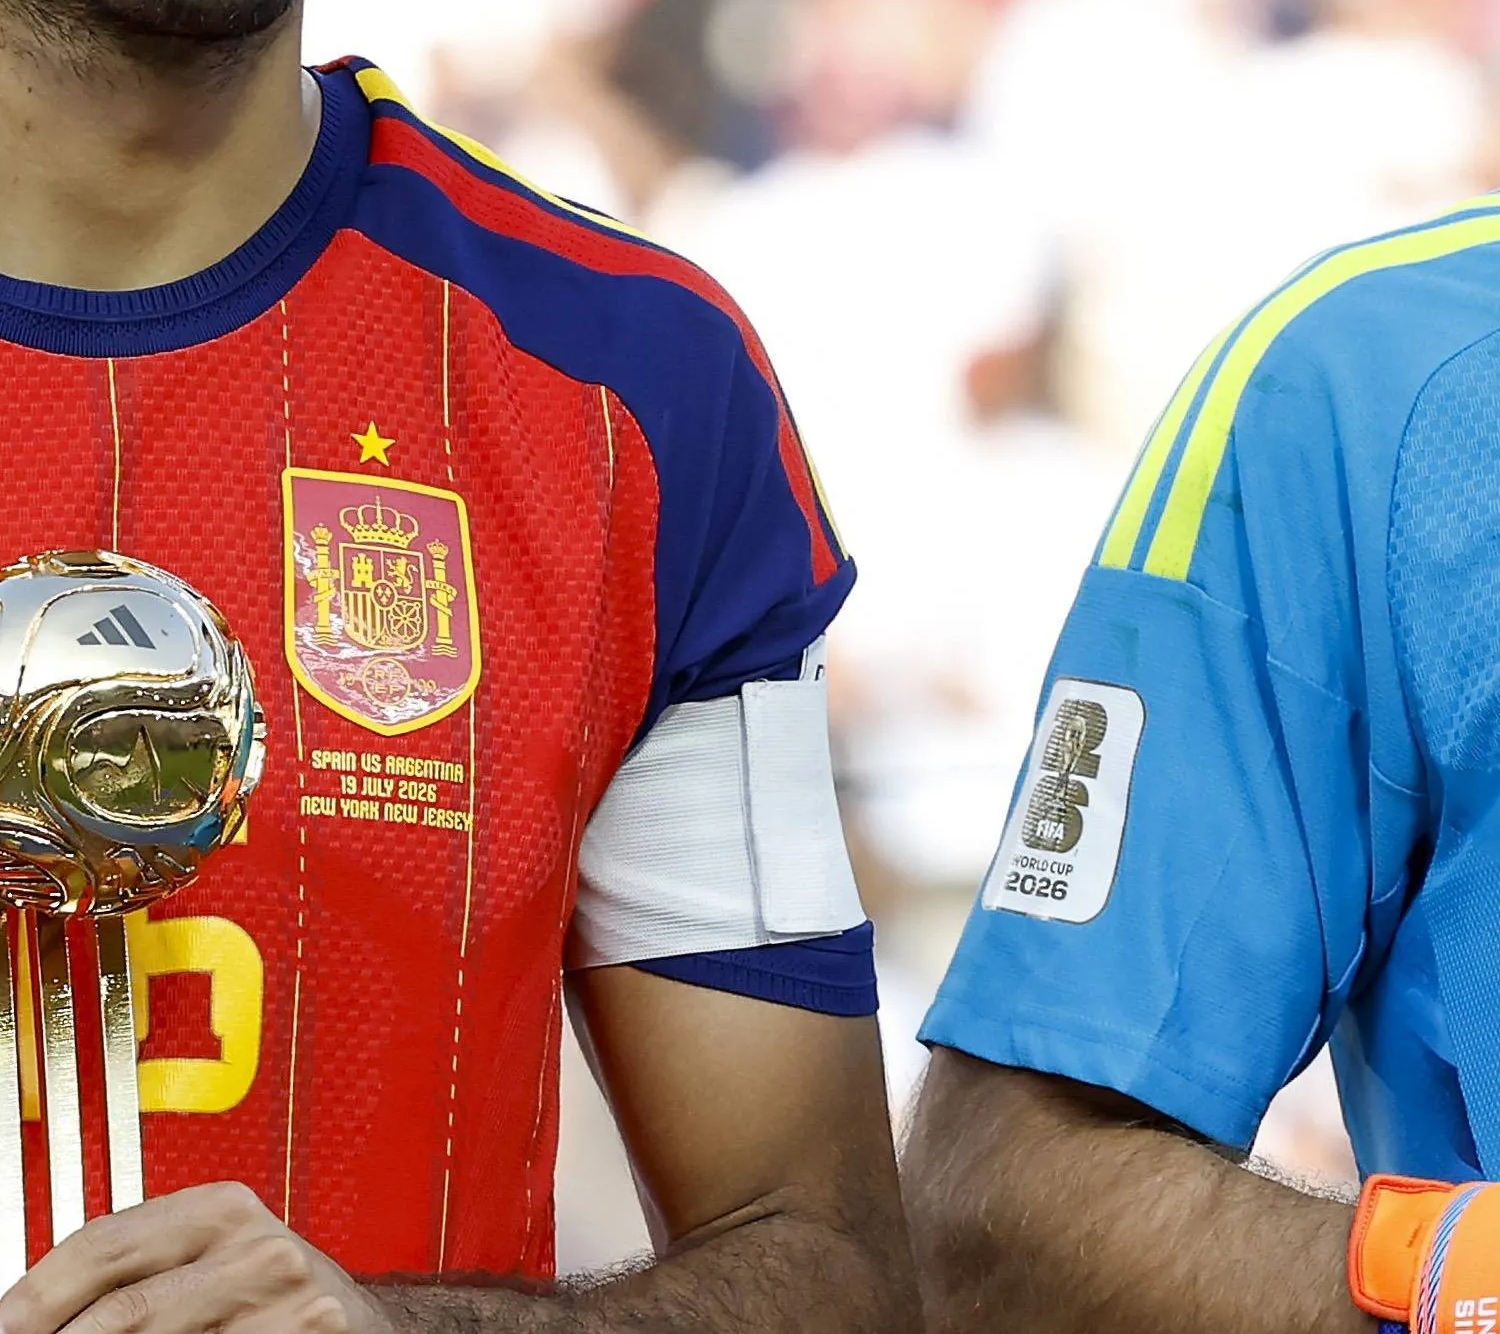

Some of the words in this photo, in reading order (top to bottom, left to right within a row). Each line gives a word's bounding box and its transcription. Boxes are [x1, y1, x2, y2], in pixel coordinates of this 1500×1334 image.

[311, 750, 357, 771] SPAIN
[385, 755, 464, 783] ARGENTINA
[340, 774, 357, 794] 19
[361, 777, 394, 797] JULY
[398, 780, 437, 802] 2026
[300, 795, 336, 817] NEW
[340, 798, 380, 821] YORK
[383, 802, 418, 824] NEW
[421, 806, 473, 832] JERSEY
[1036, 819, 1064, 840] FIFA
[1050, 861, 1074, 876] CUP
[1005, 871, 1069, 901] 2026
